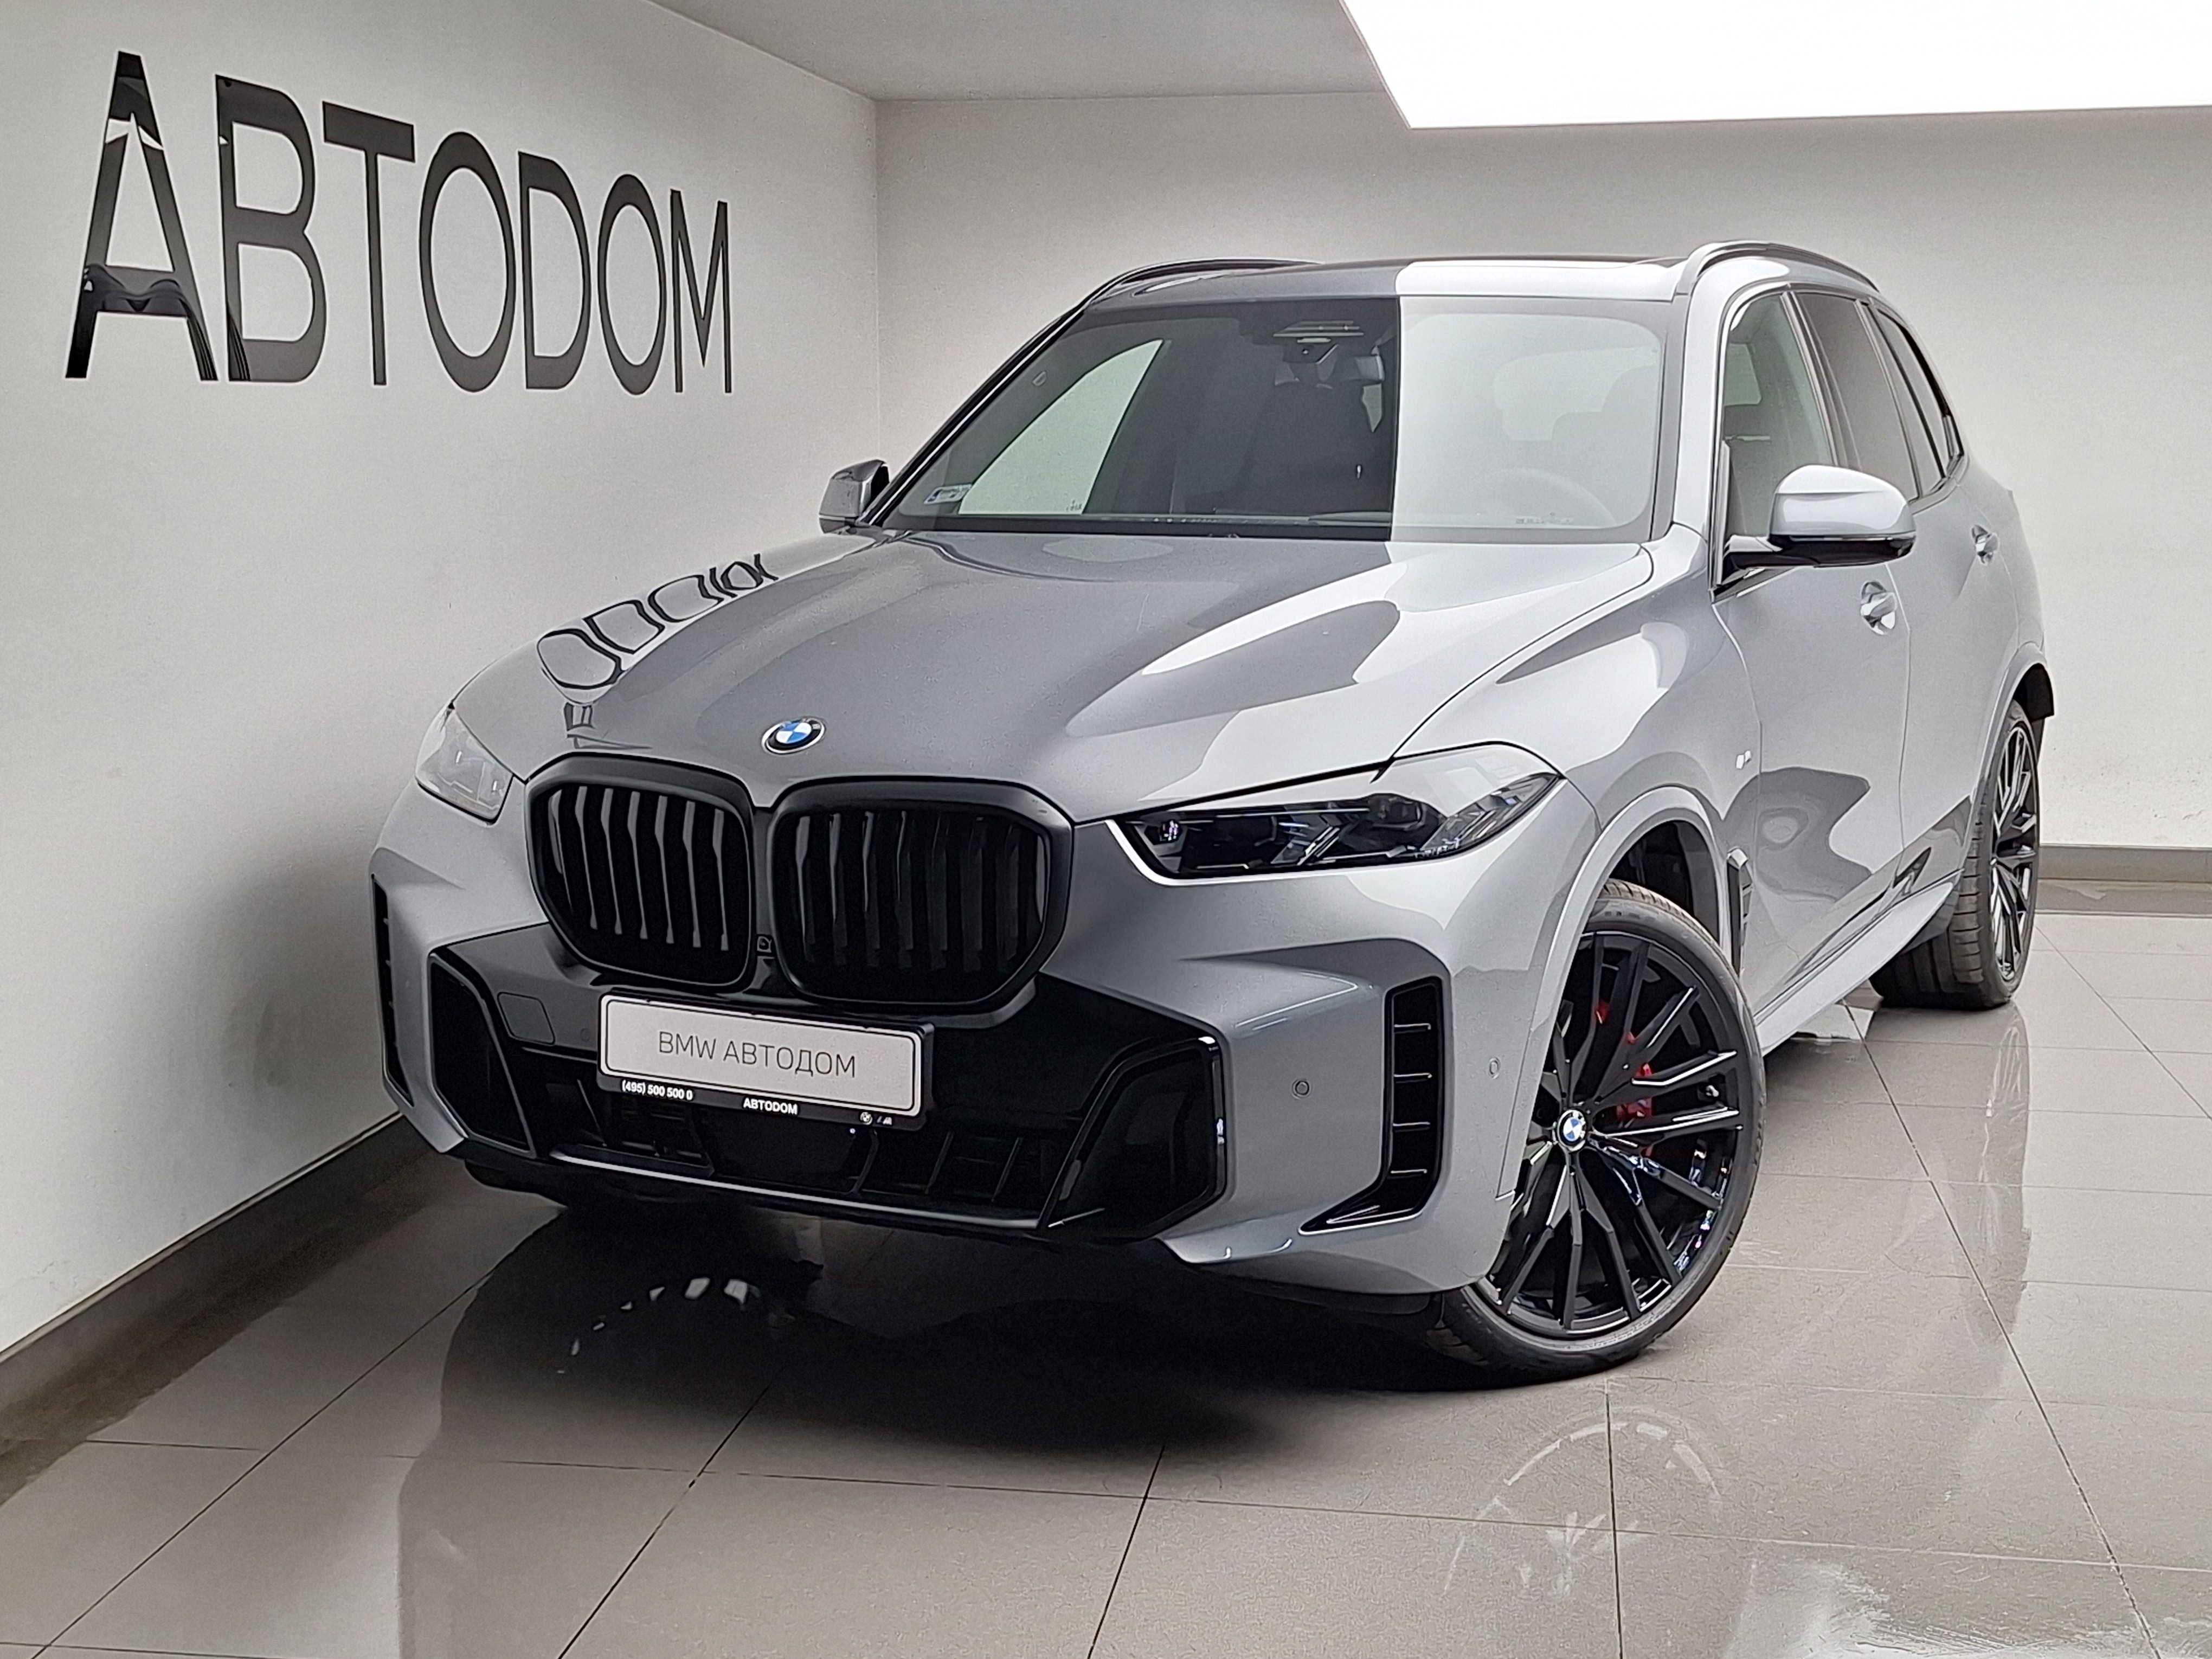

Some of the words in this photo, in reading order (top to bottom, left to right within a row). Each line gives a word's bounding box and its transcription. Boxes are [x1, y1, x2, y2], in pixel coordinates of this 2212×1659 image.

[659, 1031, 716, 1059] BMW
[723, 1040, 855, 1078] АВТОДОМ
[622, 1079, 646, 1095] (495)
[647, 1085, 665, 1096] 500
[667, 1087, 685, 1099] 500
[686, 1090, 693, 1100] 0
